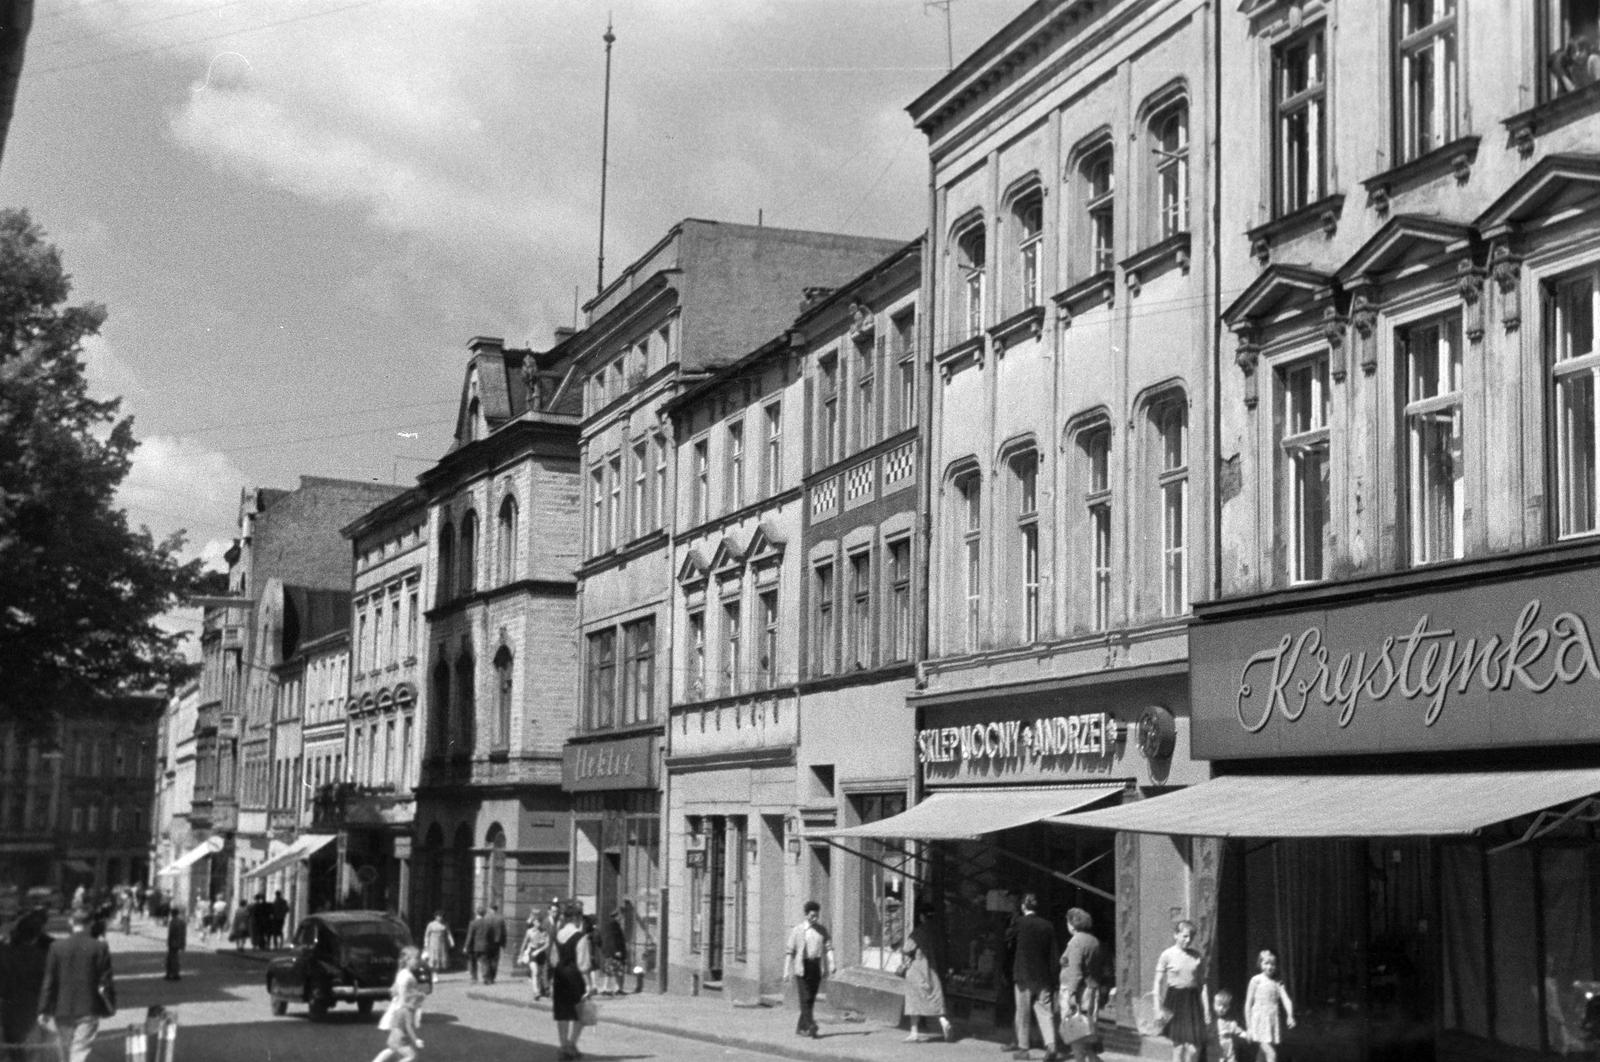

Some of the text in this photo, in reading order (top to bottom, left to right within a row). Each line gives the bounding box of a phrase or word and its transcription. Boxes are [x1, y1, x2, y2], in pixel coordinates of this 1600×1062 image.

[1237, 598, 1600, 732] Krystynka
[918, 711, 1106, 763] SKLEP NOCNY ANDRZEJ
